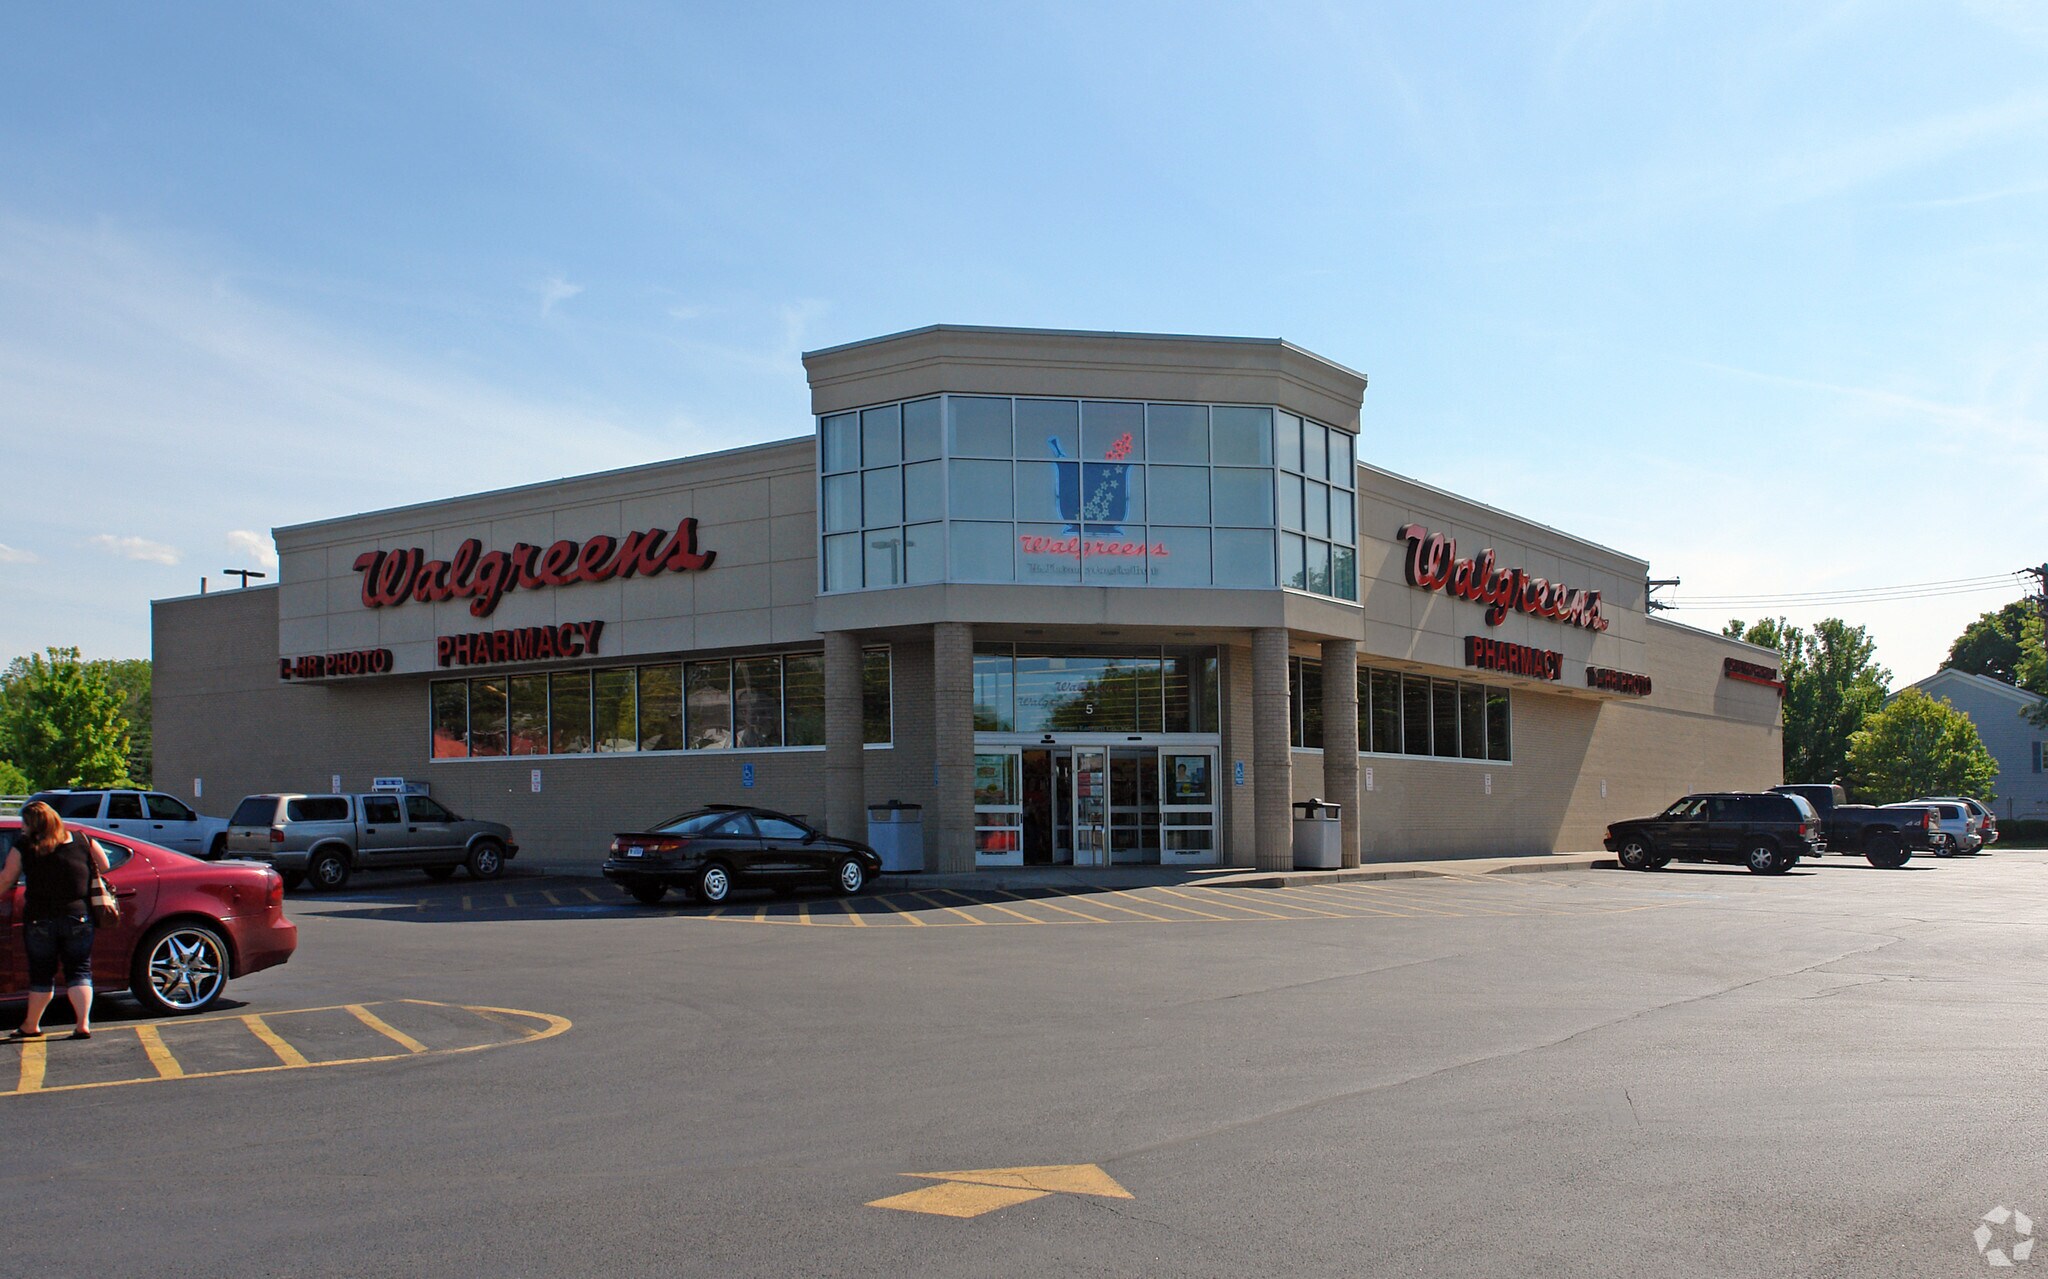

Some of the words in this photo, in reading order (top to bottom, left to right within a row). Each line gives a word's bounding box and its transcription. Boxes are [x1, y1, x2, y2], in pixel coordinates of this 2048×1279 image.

[353, 517, 717, 618] Walgreens
[1019, 535, 1169, 560] Walgreens
[1396, 522, 1609, 631] Walgreens
[325, 648, 394, 676] PHOTO
[437, 620, 605, 667] PHARMACY
[1464, 635, 1563, 680] PHARMACY
[1085, 704, 1094, 715] 5
